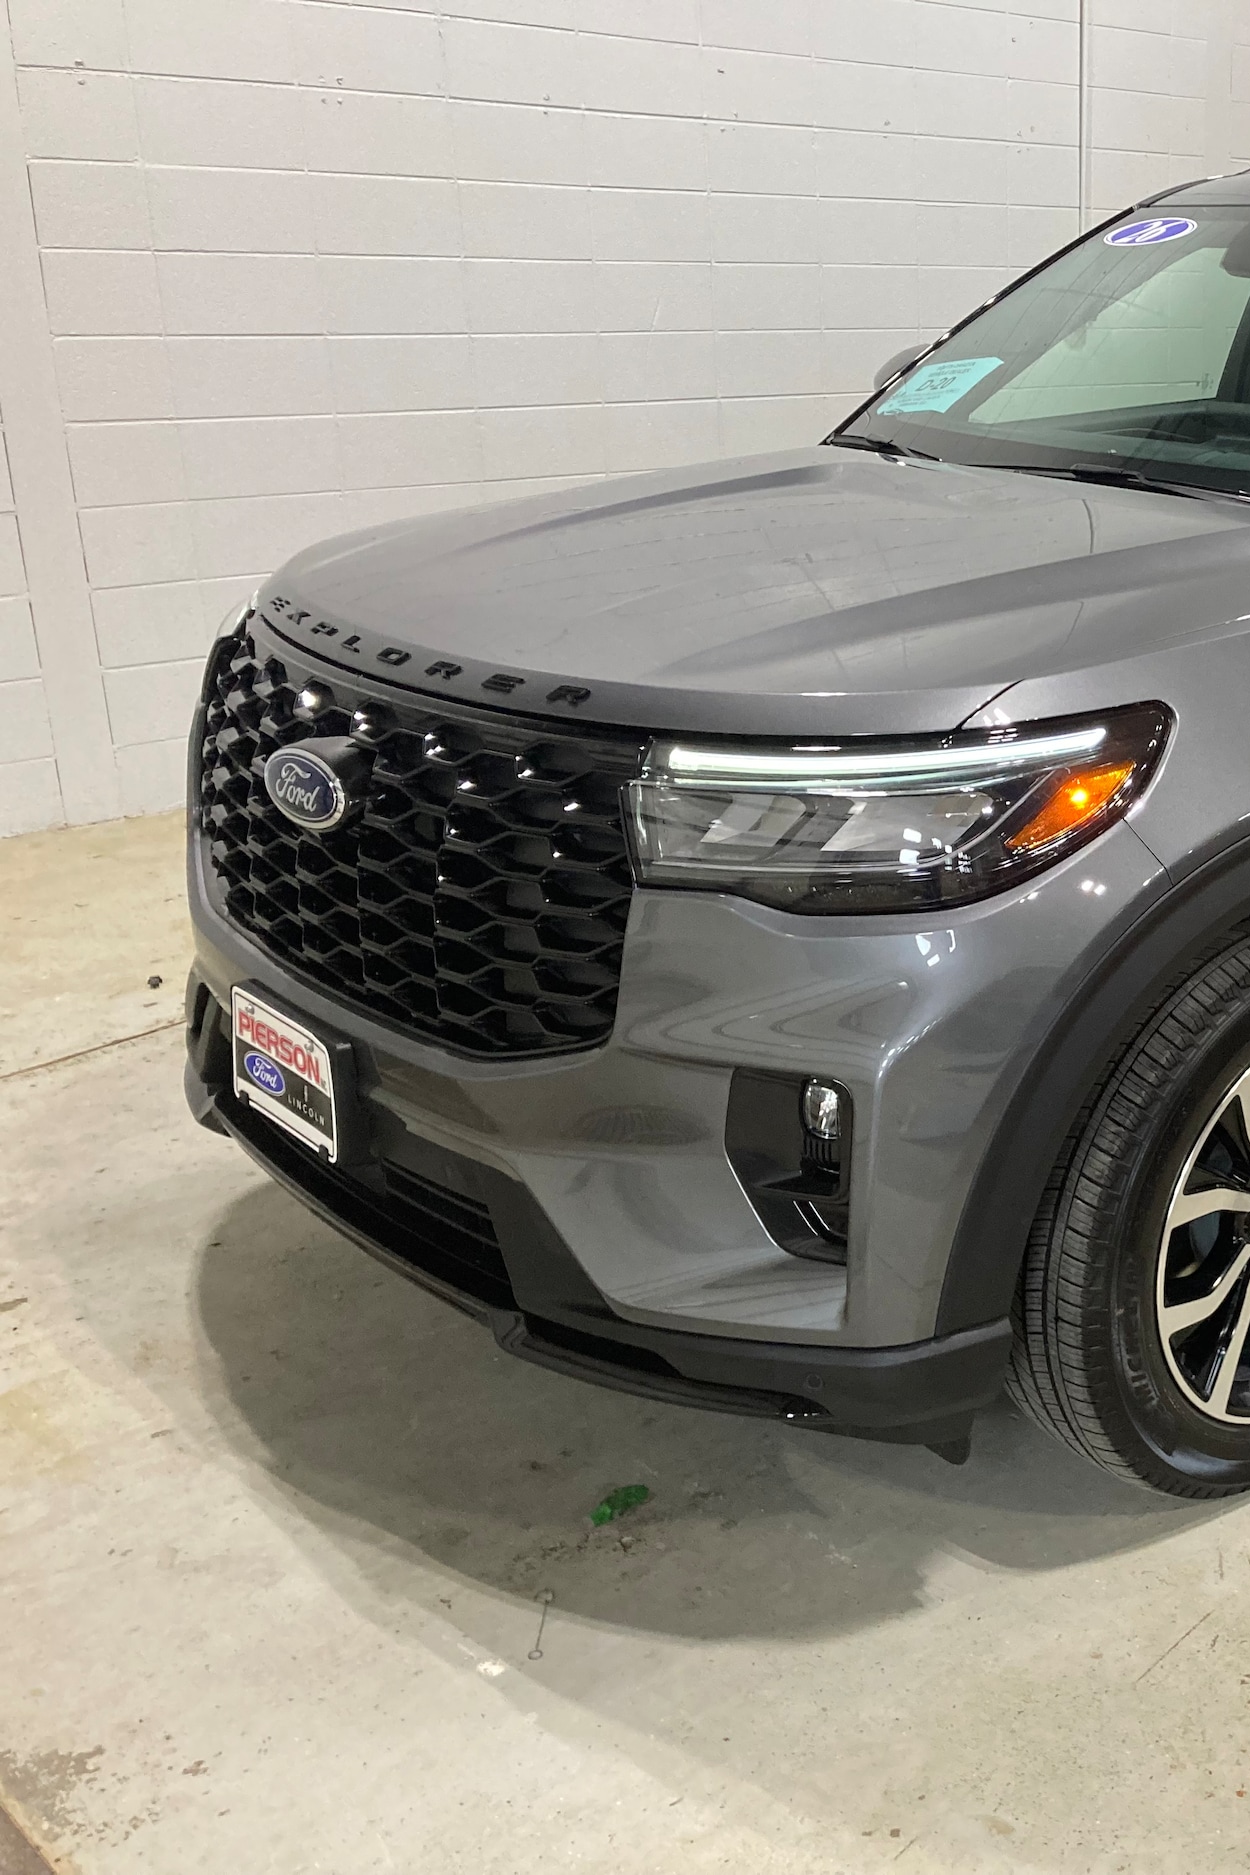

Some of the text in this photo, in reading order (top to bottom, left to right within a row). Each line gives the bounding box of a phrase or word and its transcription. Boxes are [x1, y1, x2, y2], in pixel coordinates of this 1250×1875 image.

[1112, 220, 1187, 243] 26
[914, 376, 957, 392] D-20
[268, 596, 591, 706] EXPLORER
[275, 762, 321, 812] Ford
[238, 1008, 321, 1085] PIERSON
[252, 1057, 278, 1089] Ford
[287, 1094, 325, 1126] LINCOLN
